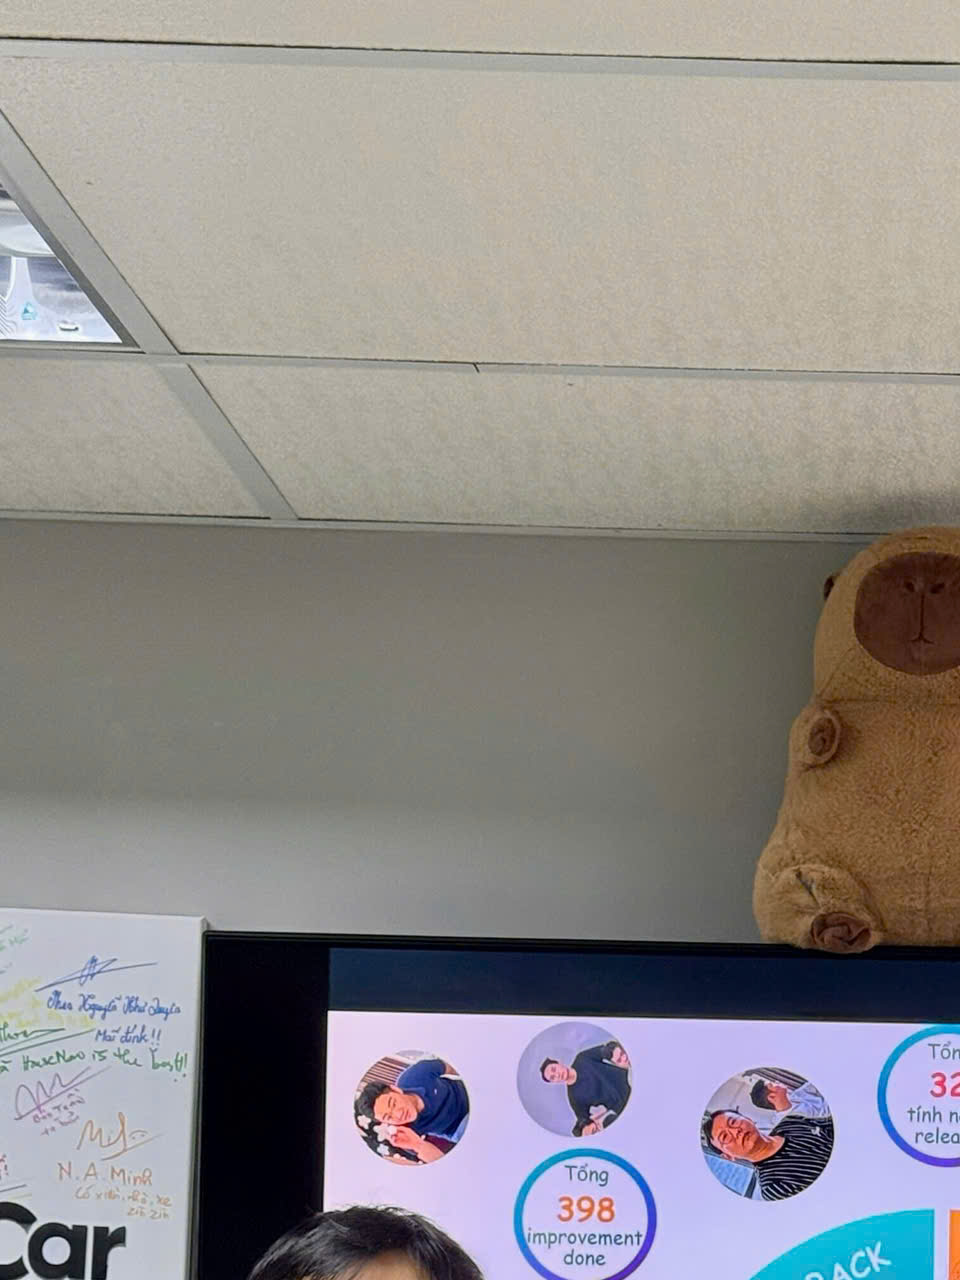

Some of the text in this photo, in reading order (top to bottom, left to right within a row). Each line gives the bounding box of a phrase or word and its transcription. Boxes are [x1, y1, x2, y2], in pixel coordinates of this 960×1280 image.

[907, 1105, 942, 1123] tính
[557, 1196, 615, 1223] 398
[527, 1227, 643, 1249] improvement
[563, 1248, 606, 1266] done
